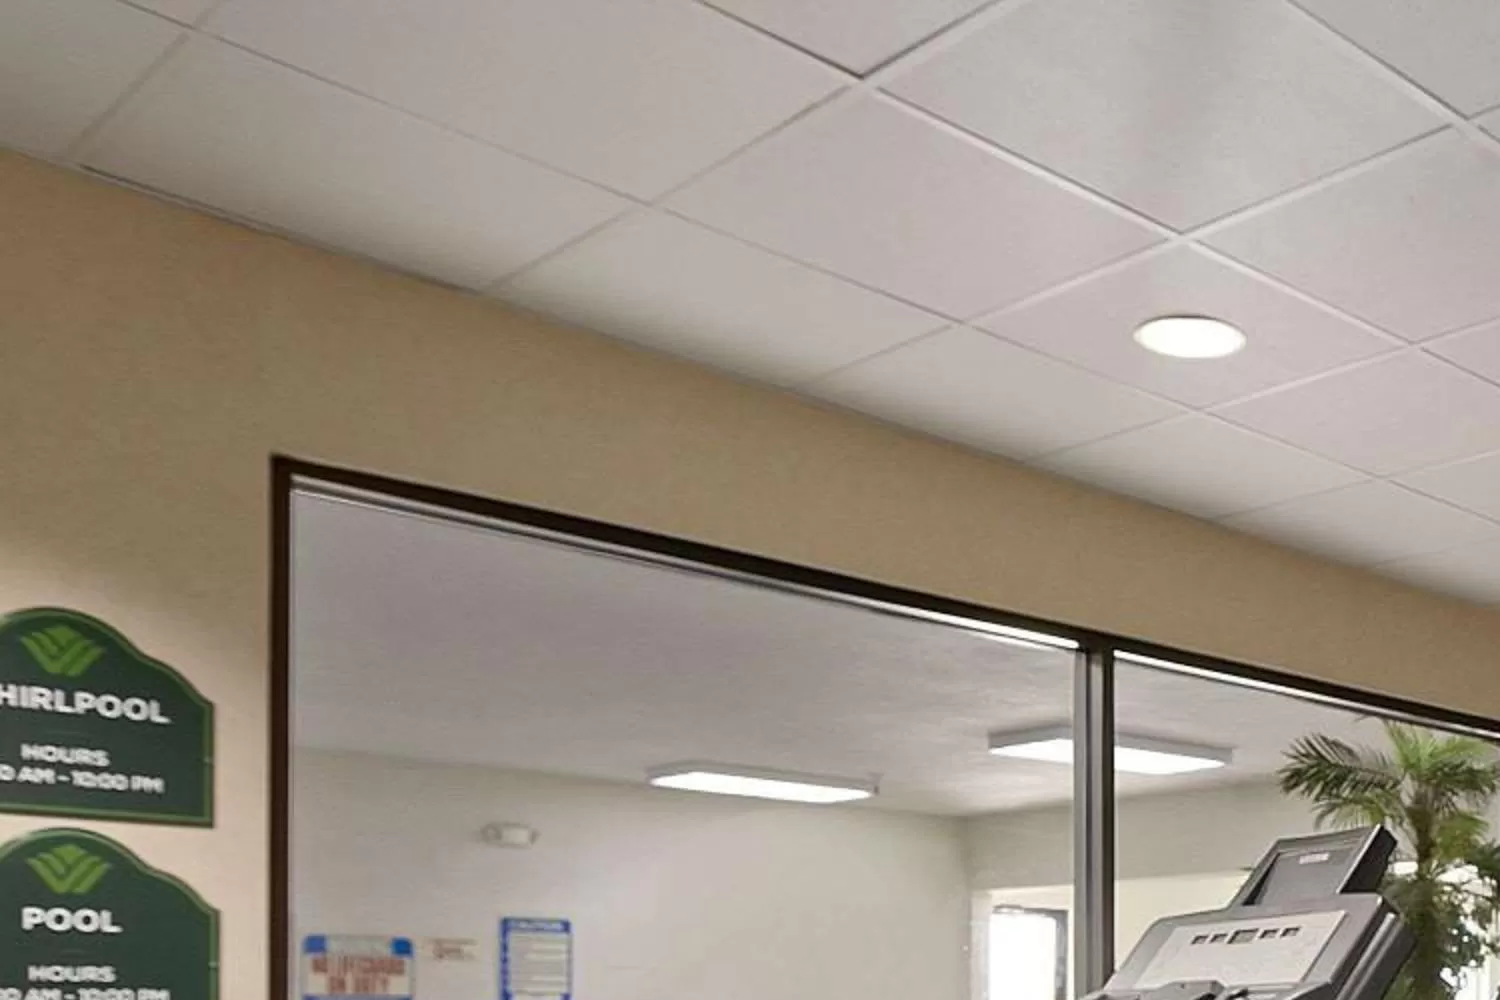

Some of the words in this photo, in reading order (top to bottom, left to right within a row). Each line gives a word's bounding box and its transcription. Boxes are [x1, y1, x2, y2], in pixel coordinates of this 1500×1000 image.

[20, 743, 111, 767] HOURS
[16, 765, 56, 785] AM
[130, 774, 166, 794] PM
[21, 906, 124, 933] POOL
[27, 965, 117, 983] HOURS
